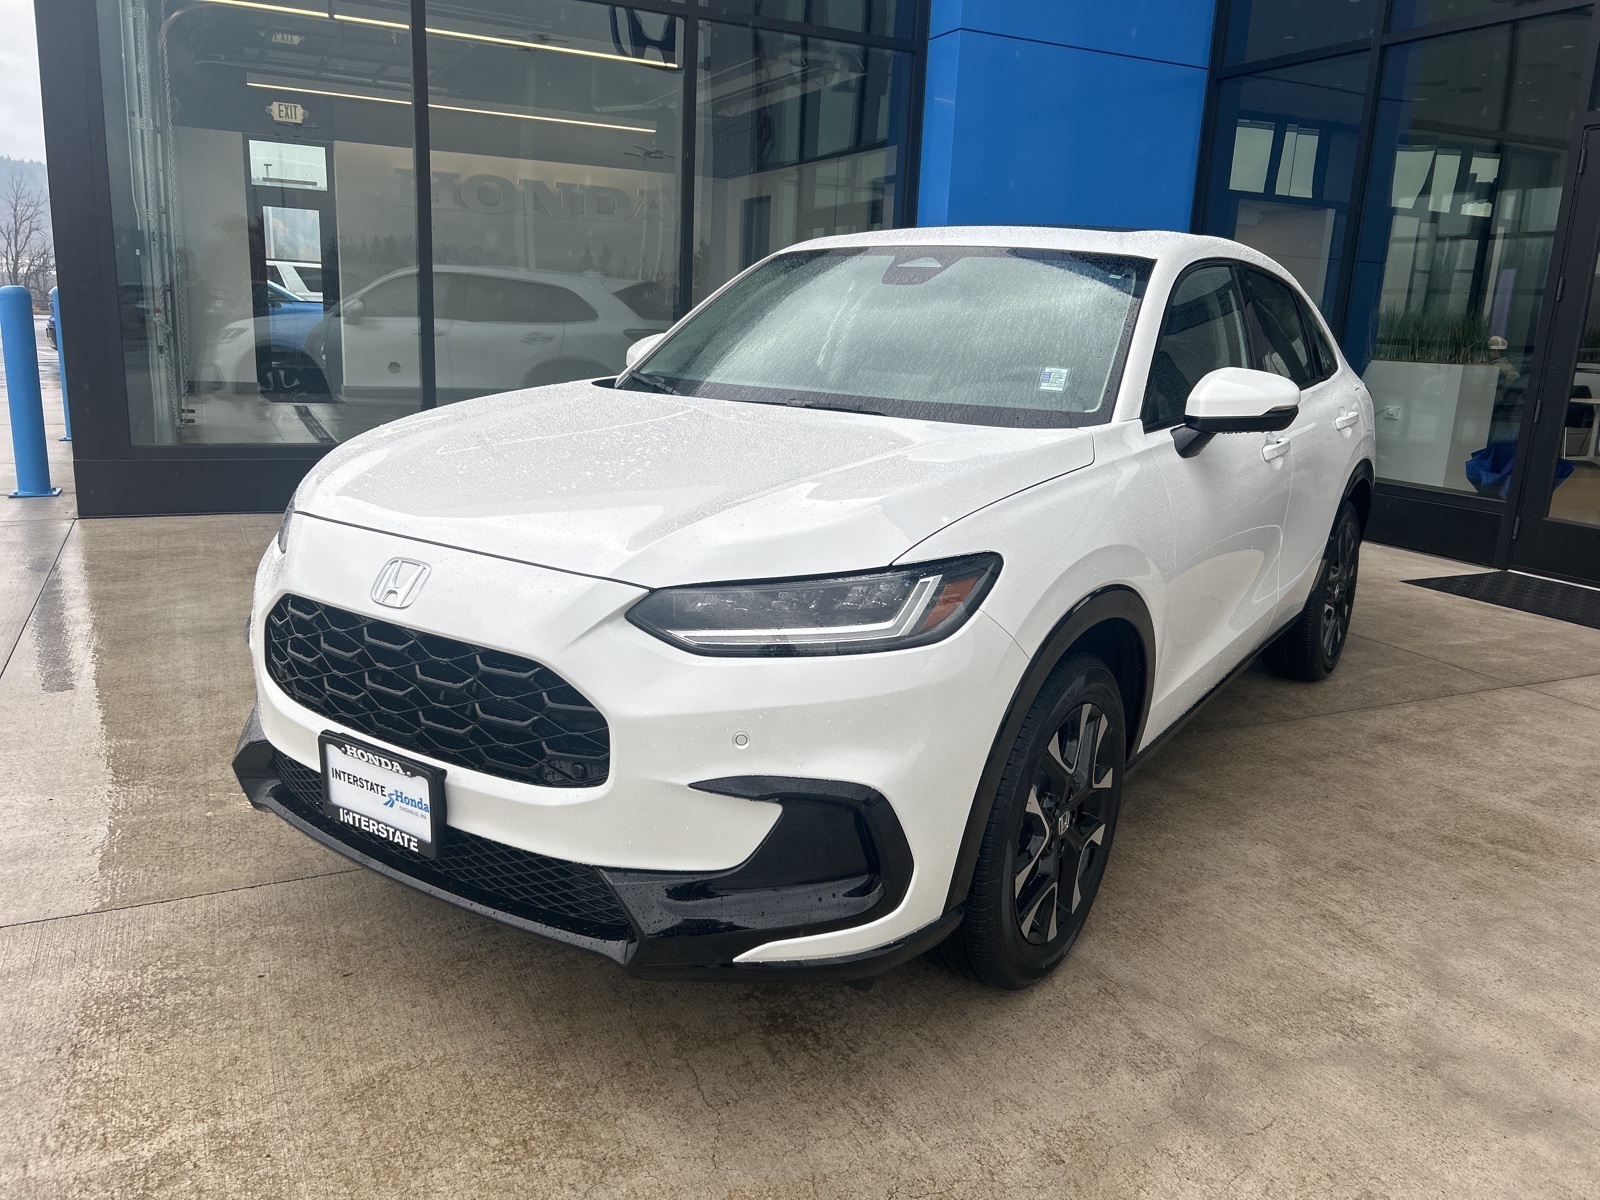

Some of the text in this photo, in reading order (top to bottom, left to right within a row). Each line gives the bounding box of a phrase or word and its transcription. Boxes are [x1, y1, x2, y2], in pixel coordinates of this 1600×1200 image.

[277, 103, 298, 120] EXIT
[394, 168, 681, 227] HONDA
[344, 744, 406, 776] HONDA
[331, 767, 430, 813] INTERSTATE Honda
[339, 808, 419, 853] INTERSTATE
